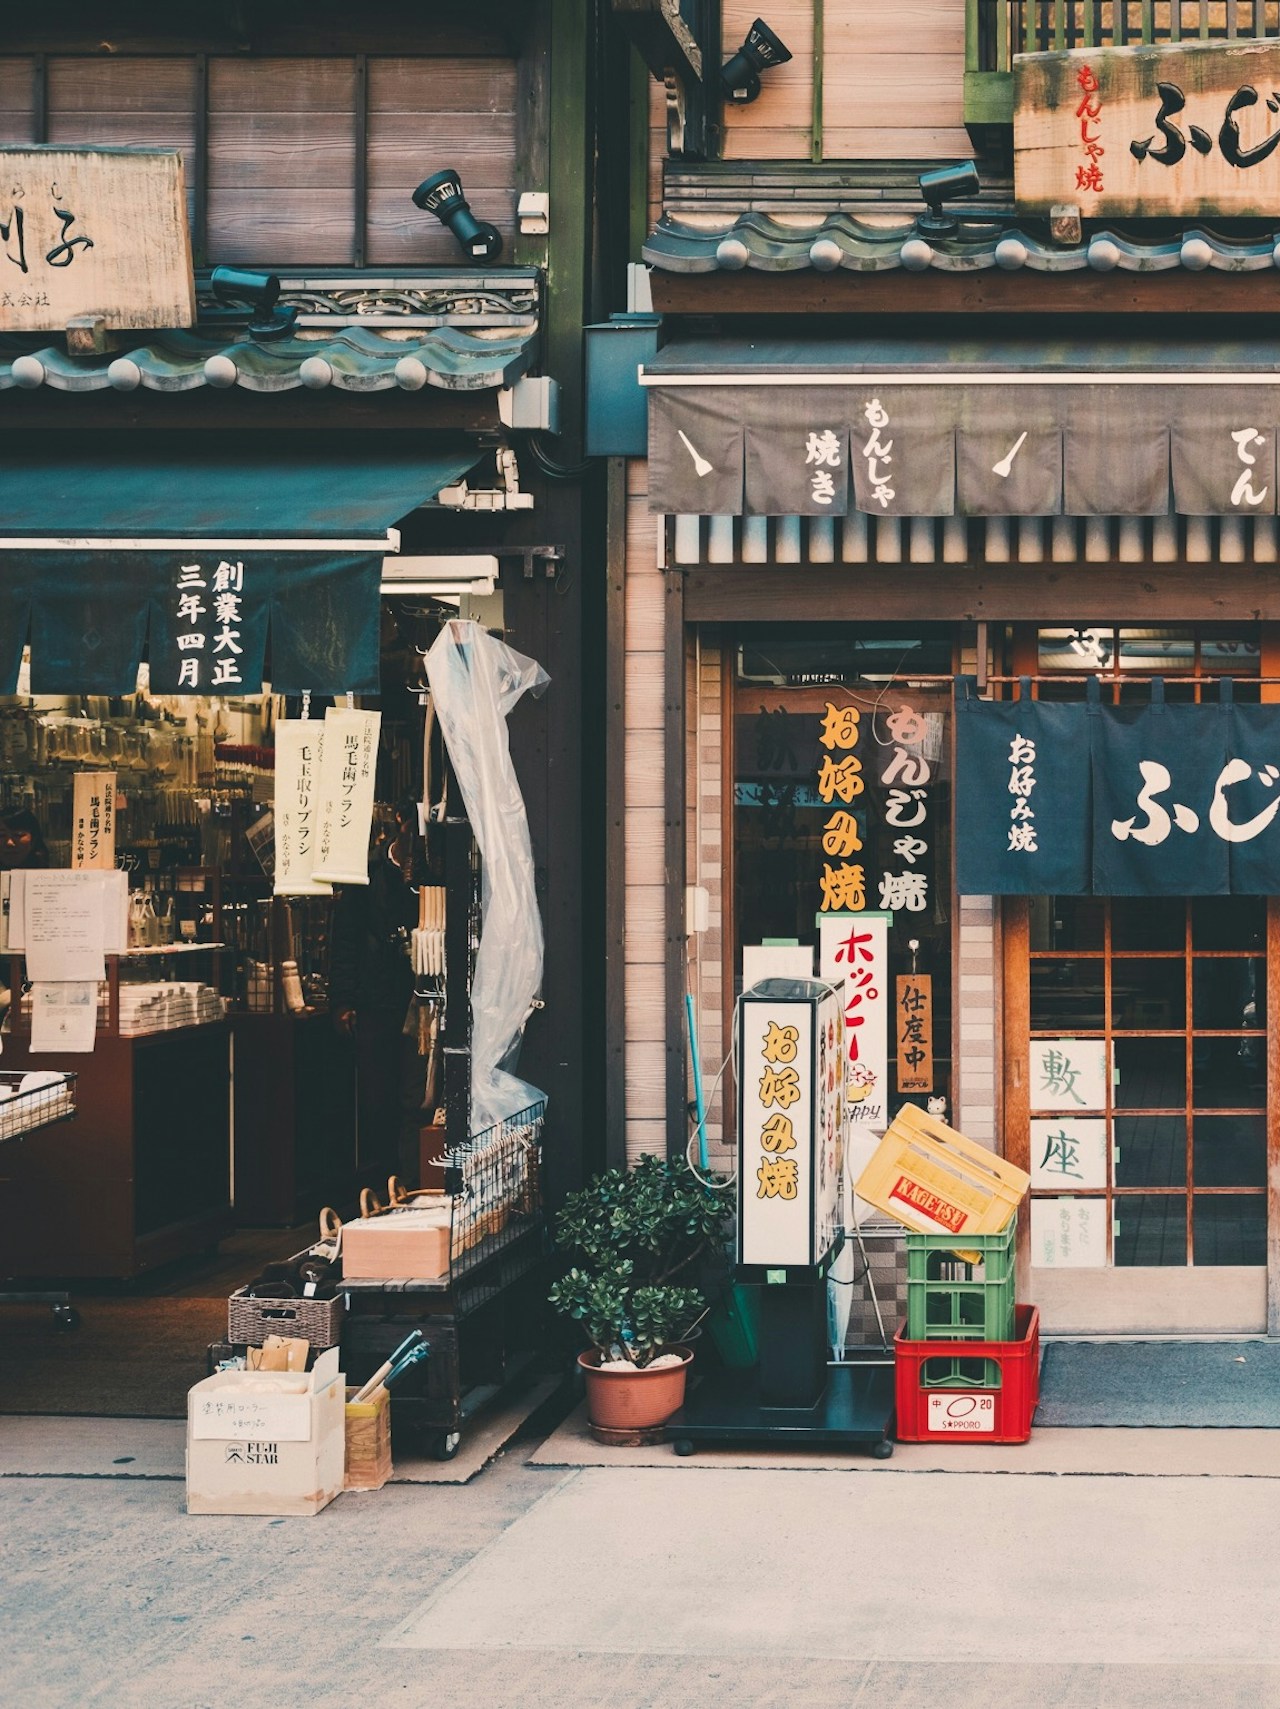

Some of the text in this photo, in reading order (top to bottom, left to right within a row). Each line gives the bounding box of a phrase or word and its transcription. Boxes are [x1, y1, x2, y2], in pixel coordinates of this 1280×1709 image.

[1075, 64, 1104, 192] もんじゃ焼
[805, 429, 842, 505] 焼き
[863, 398, 896, 509] もんじゃ
[1230, 427, 1269, 507] でん
[176, 564, 207, 688] 三年四月
[211, 560, 245, 687] 創業大正
[818, 702, 866, 913] お好み焼
[878, 705, 931, 912] もんじゃ焼
[1006, 733, 1039, 853] お好み焼
[835, 924, 878, 1062] ホッピー
[901, 984, 928, 1073] 仕度中
[757, 1020, 801, 1201] お好み焼
[1040, 1048, 1087, 1106] 敷
[1040, 1129, 1084, 1180] 座
[896, 1177, 966, 1226] KAGETSU
[247, 1442, 278, 1454] FUJI
[933, 1399, 942, 1408] 中
[980, 1398, 992, 1410] 20
[246, 1454, 279, 1465] STAR
